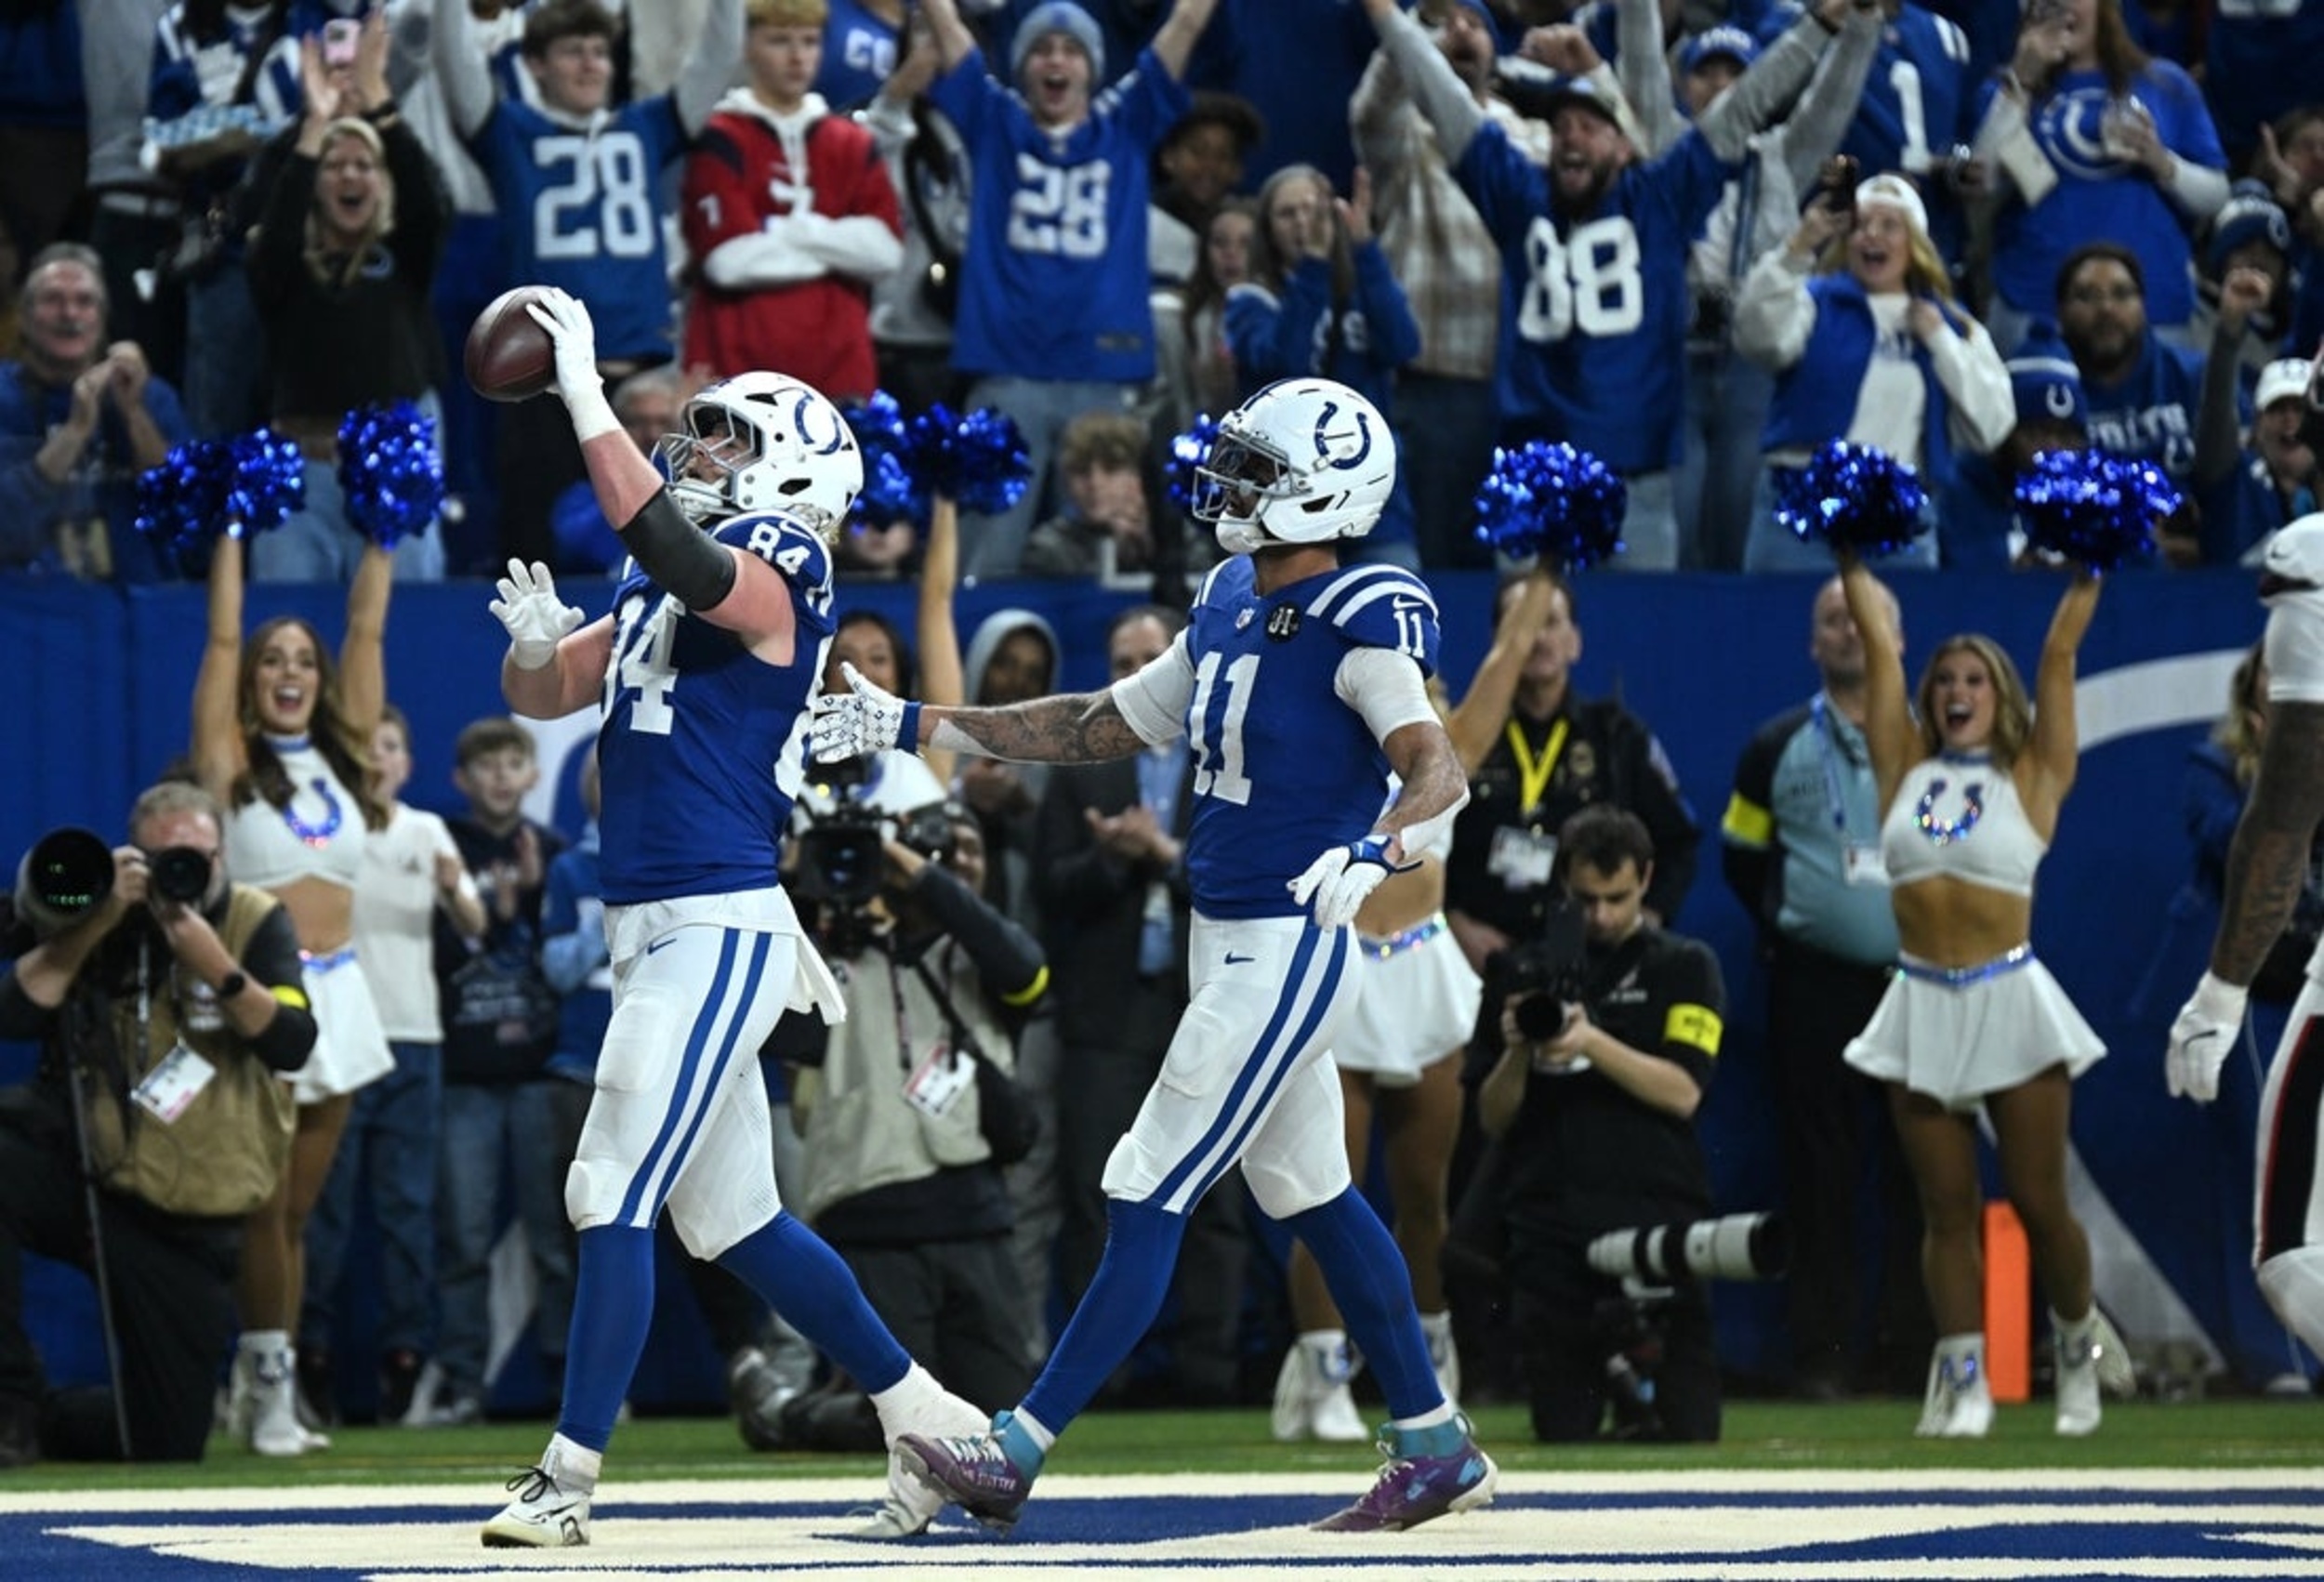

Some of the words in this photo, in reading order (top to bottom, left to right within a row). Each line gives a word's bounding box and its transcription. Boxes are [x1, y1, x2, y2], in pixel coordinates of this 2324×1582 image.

[534, 131, 654, 258] 28
[1008, 151, 1110, 257] 28
[1518, 214, 1644, 342] 88
[746, 521, 812, 574] 84
[1393, 610, 1425, 658] 11
[1189, 650, 1261, 806] 11
